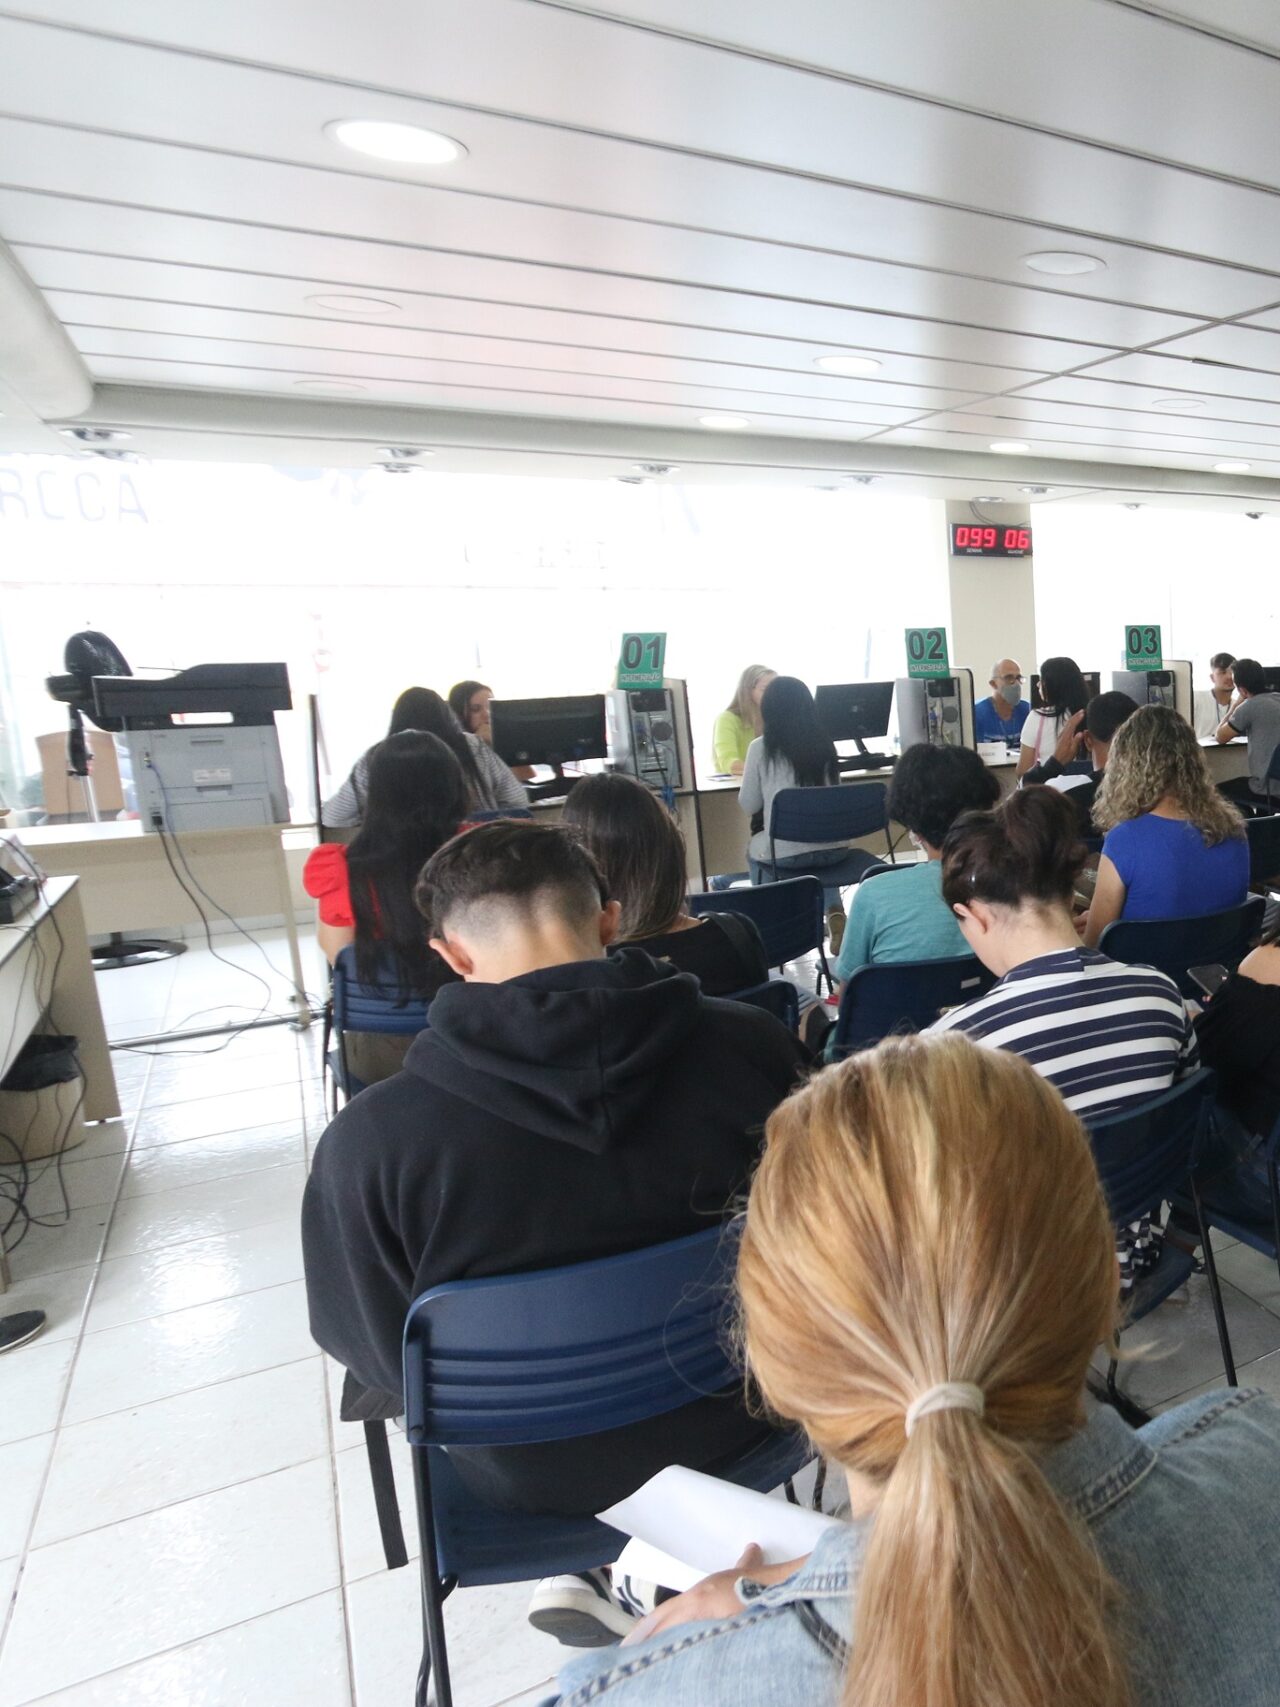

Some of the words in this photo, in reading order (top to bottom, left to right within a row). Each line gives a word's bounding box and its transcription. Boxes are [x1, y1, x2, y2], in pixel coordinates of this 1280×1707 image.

[956, 527, 996, 547] 099
[1004, 529, 1029, 548] 06
[622, 635, 661, 668] 01
[908, 630, 945, 661] 02
[1128, 627, 1158, 655] 03
